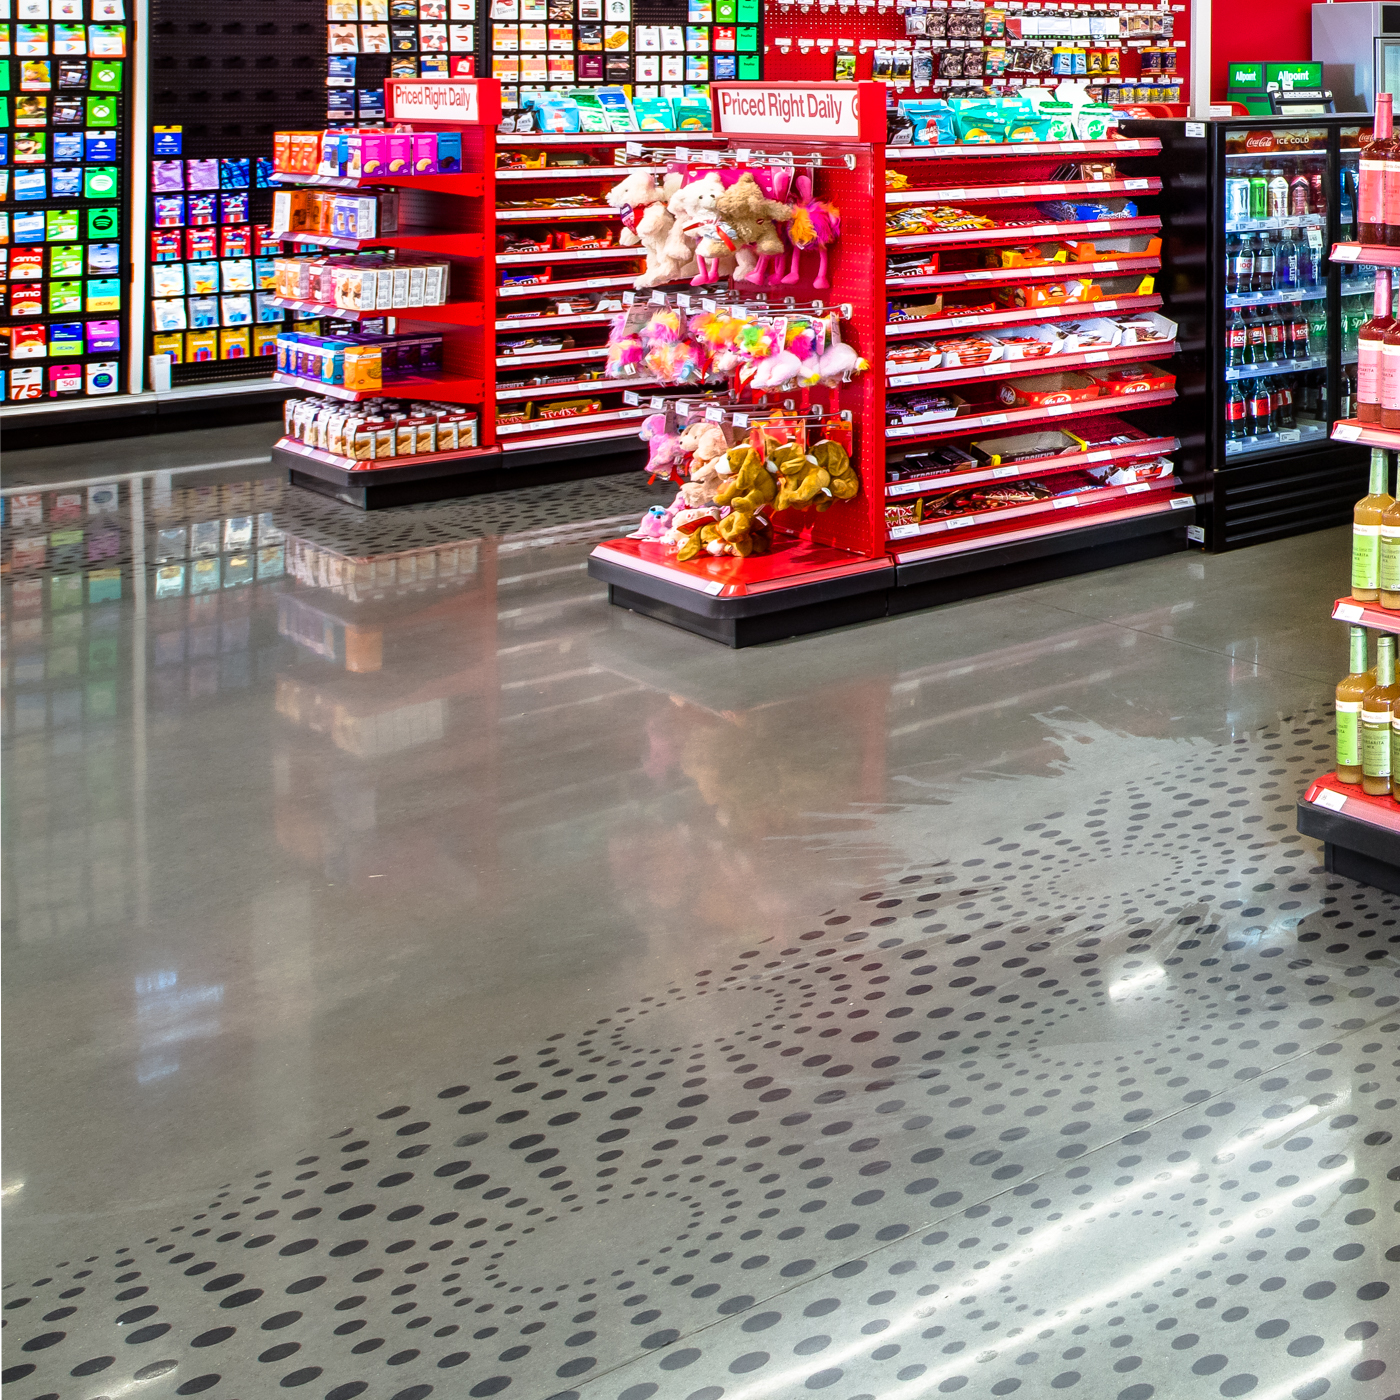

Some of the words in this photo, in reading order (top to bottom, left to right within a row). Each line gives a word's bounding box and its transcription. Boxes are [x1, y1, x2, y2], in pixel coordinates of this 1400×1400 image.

[1277, 70, 1310, 83] Allpoint
[395, 86, 424, 105] Priced
[424, 87, 448, 110] Right
[449, 89, 471, 111] Daily
[722, 89, 765, 121] Priced
[767, 92, 801, 126] Right
[802, 92, 842, 127] Daily
[1289, 137, 1310, 145] COLD
